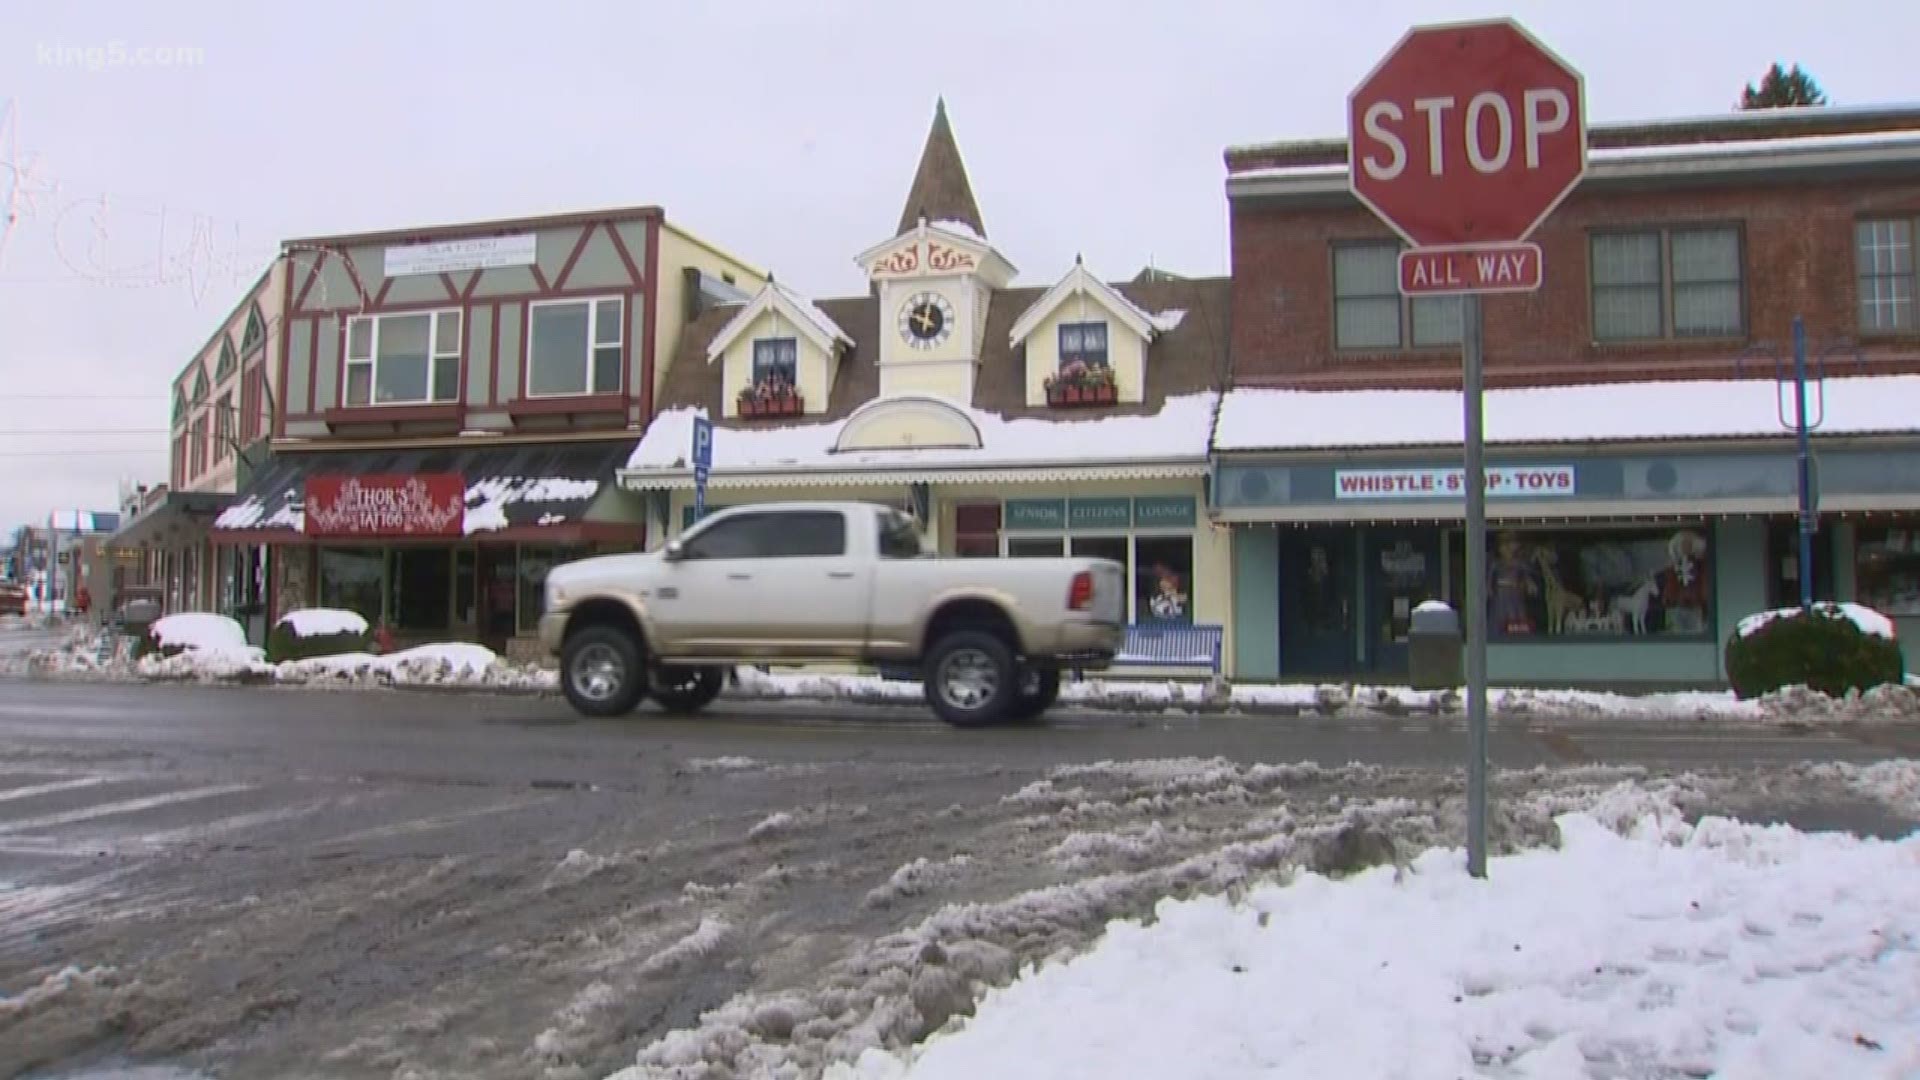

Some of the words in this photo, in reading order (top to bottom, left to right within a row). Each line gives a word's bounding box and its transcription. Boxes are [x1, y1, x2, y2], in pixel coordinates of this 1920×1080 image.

[1362, 88, 1570, 181] STOP
[1413, 258, 1460, 286] ALL
[1477, 254, 1526, 282] WAY
[697, 425, 710, 459] P
[1340, 474, 1434, 492] WHISTLE
[1515, 472, 1571, 490] TOYS
[357, 487, 409, 507] THOR'S
[360, 510, 404, 530] TATTOO
[1013, 506, 1058, 520] SENIOR
[1072, 505, 1127, 519] CITIZENS
[1139, 504, 1189, 518] LOUNGE
